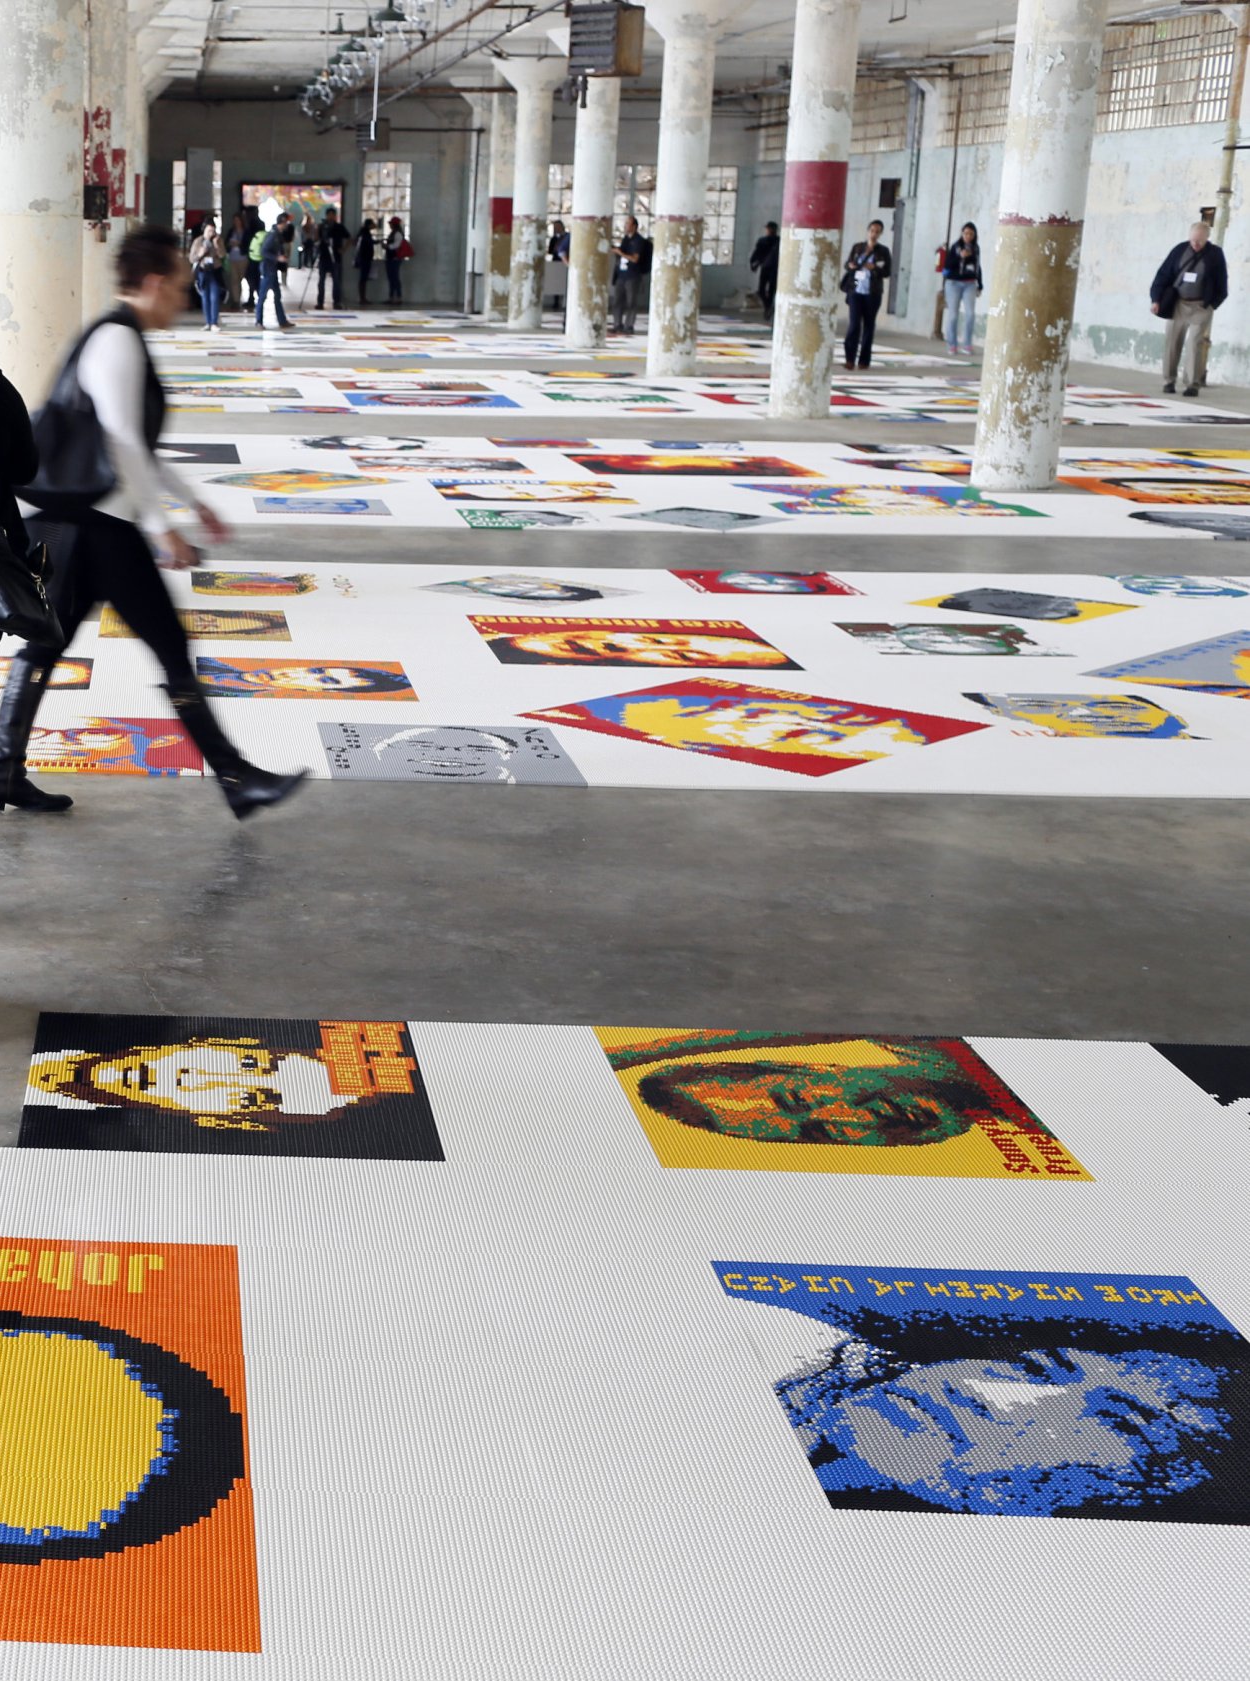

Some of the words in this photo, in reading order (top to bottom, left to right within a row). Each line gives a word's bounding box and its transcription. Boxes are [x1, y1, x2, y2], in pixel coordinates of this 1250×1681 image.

[956, 1108, 1043, 1173] Somyot
[723, 1273, 855, 1295] CHANU
[867, 1278, 1084, 1302] SHARMILA
[1093, 1285, 1208, 1306] IROM
